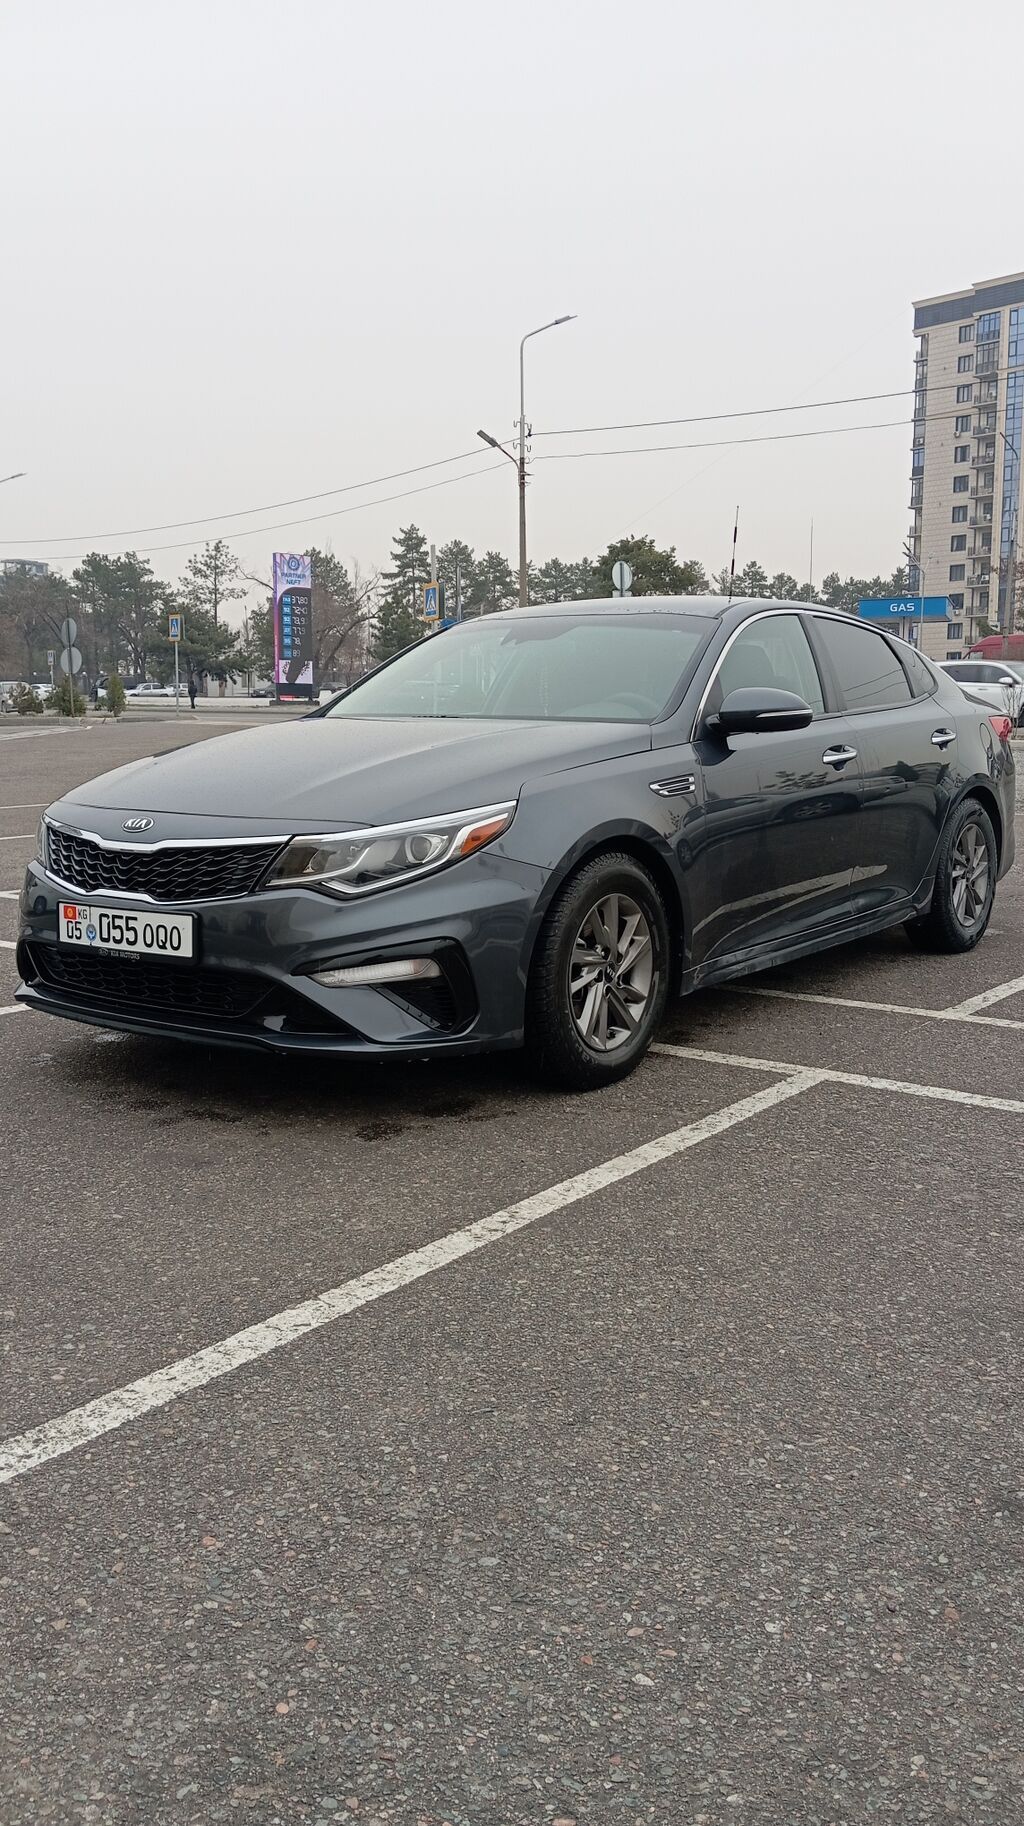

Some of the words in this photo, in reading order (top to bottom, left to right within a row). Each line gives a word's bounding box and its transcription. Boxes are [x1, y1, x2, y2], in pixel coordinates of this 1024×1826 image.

[281, 572, 306, 580] PARTNER
[890, 602, 914, 612] GAS
[125, 818, 147, 828] KIA
[77, 909, 88, 919] KG
[66, 920, 82, 940] 05
